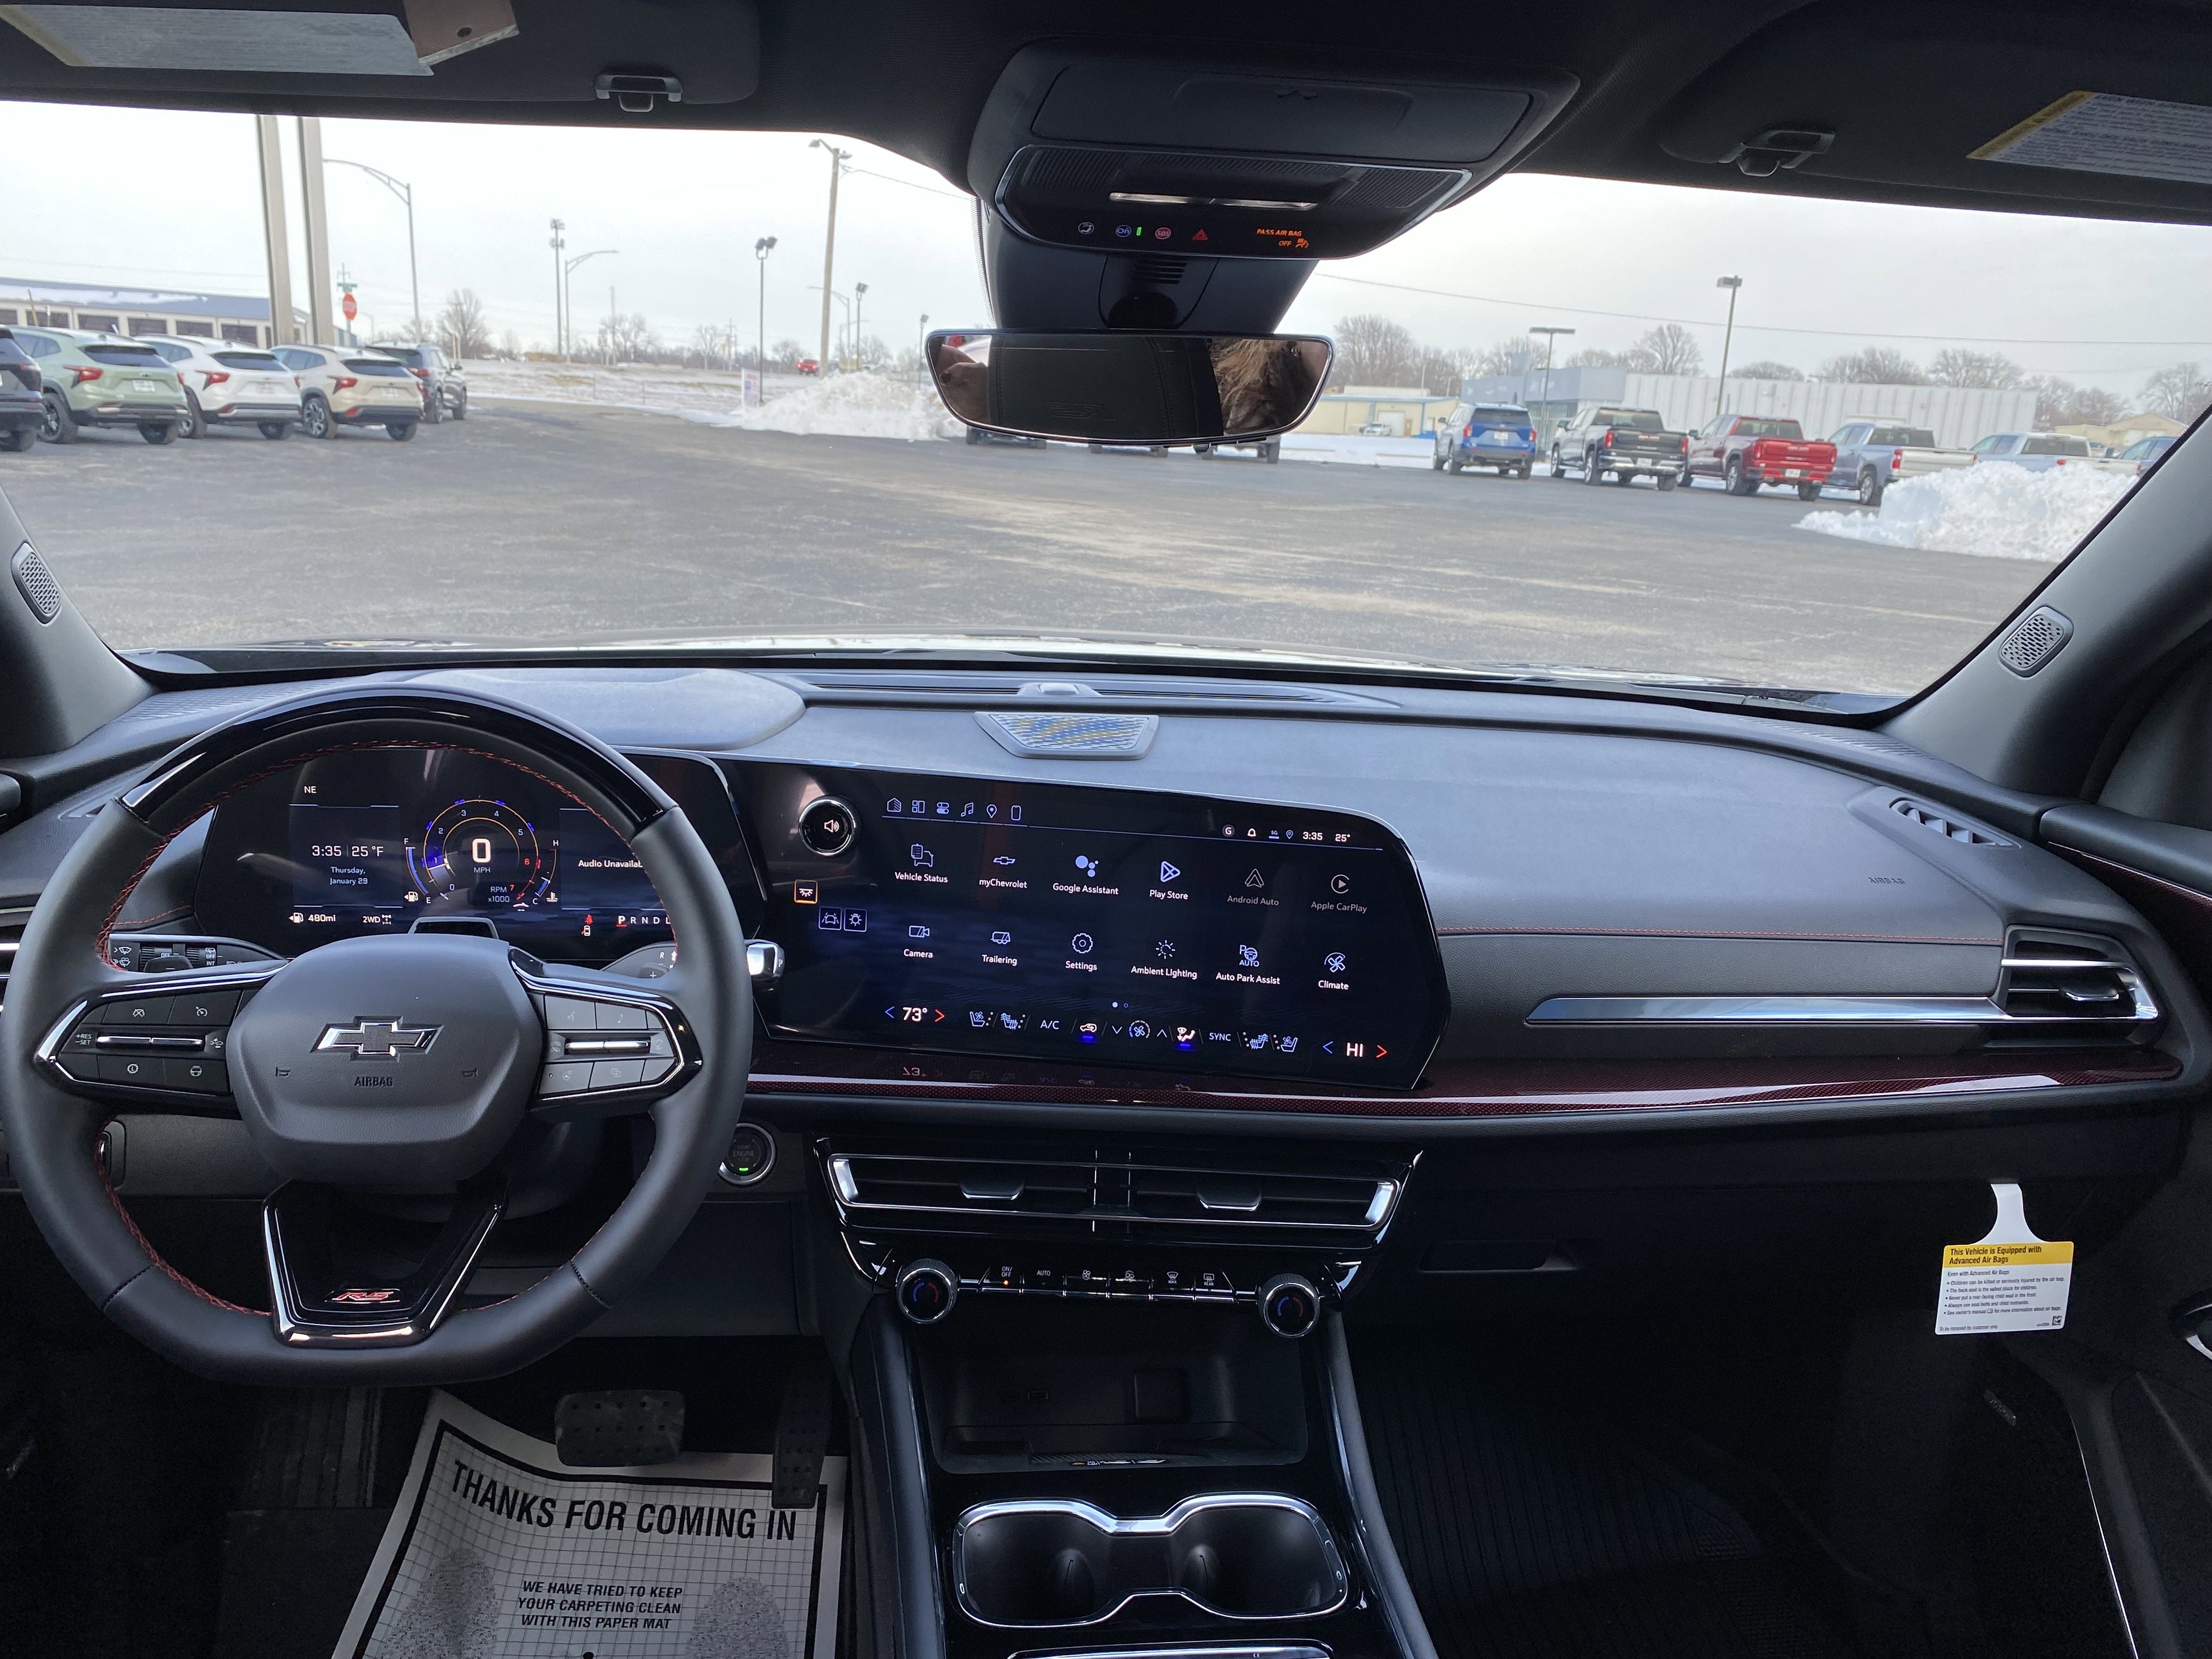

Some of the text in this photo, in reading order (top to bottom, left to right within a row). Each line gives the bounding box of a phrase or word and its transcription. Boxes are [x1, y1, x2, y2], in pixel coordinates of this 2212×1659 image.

[1302, 831, 1323, 840] 3:35
[1335, 833, 1351, 842] 25°
[312, 845, 342, 856] 3:35
[472, 838, 491, 863] 0
[578, 859, 602, 867] Audio
[330, 866, 365, 875] Thursday,
[330, 878, 356, 886] January
[894, 872, 948, 883] Vehicle Status
[979, 878, 1028, 889] myChevrolet
[1052, 883, 1119, 895] Google Assistant
[1149, 889, 1188, 900] Play Store
[1227, 895, 1279, 906] Android Auto
[1311, 901, 1368, 915] Apple CarPlay
[308, 914, 336, 922] 480mi
[618, 916, 626, 924] P
[903, 949, 933, 958] Camera
[981, 955, 1017, 966] Trailering
[1065, 961, 1097, 972] Settings
[1131, 966, 1197, 980] Ambient Lighting
[1216, 972, 1280, 985] Auto Park Assist
[1318, 980, 1349, 990] Climate
[902, 1007, 928, 1022] 73°
[1040, 1020, 1059, 1030] A/C
[1209, 1032, 1232, 1041] SYNC
[1346, 1042, 1363, 1057] HI
[354, 1076, 393, 1087] AIRBAG
[1997, 1246, 2027, 1255] Equipped
[332, 1291, 394, 1300] RS
[450, 1459, 797, 1541] THANKS FOR COMING IN
[523, 1581, 683, 1599] WE HAVE TRIED TO KEEP
[518, 1597, 681, 1614] YOUR CARPETING CLEAN
[521, 1614, 672, 1630] WITH THIS PAPER MAT
